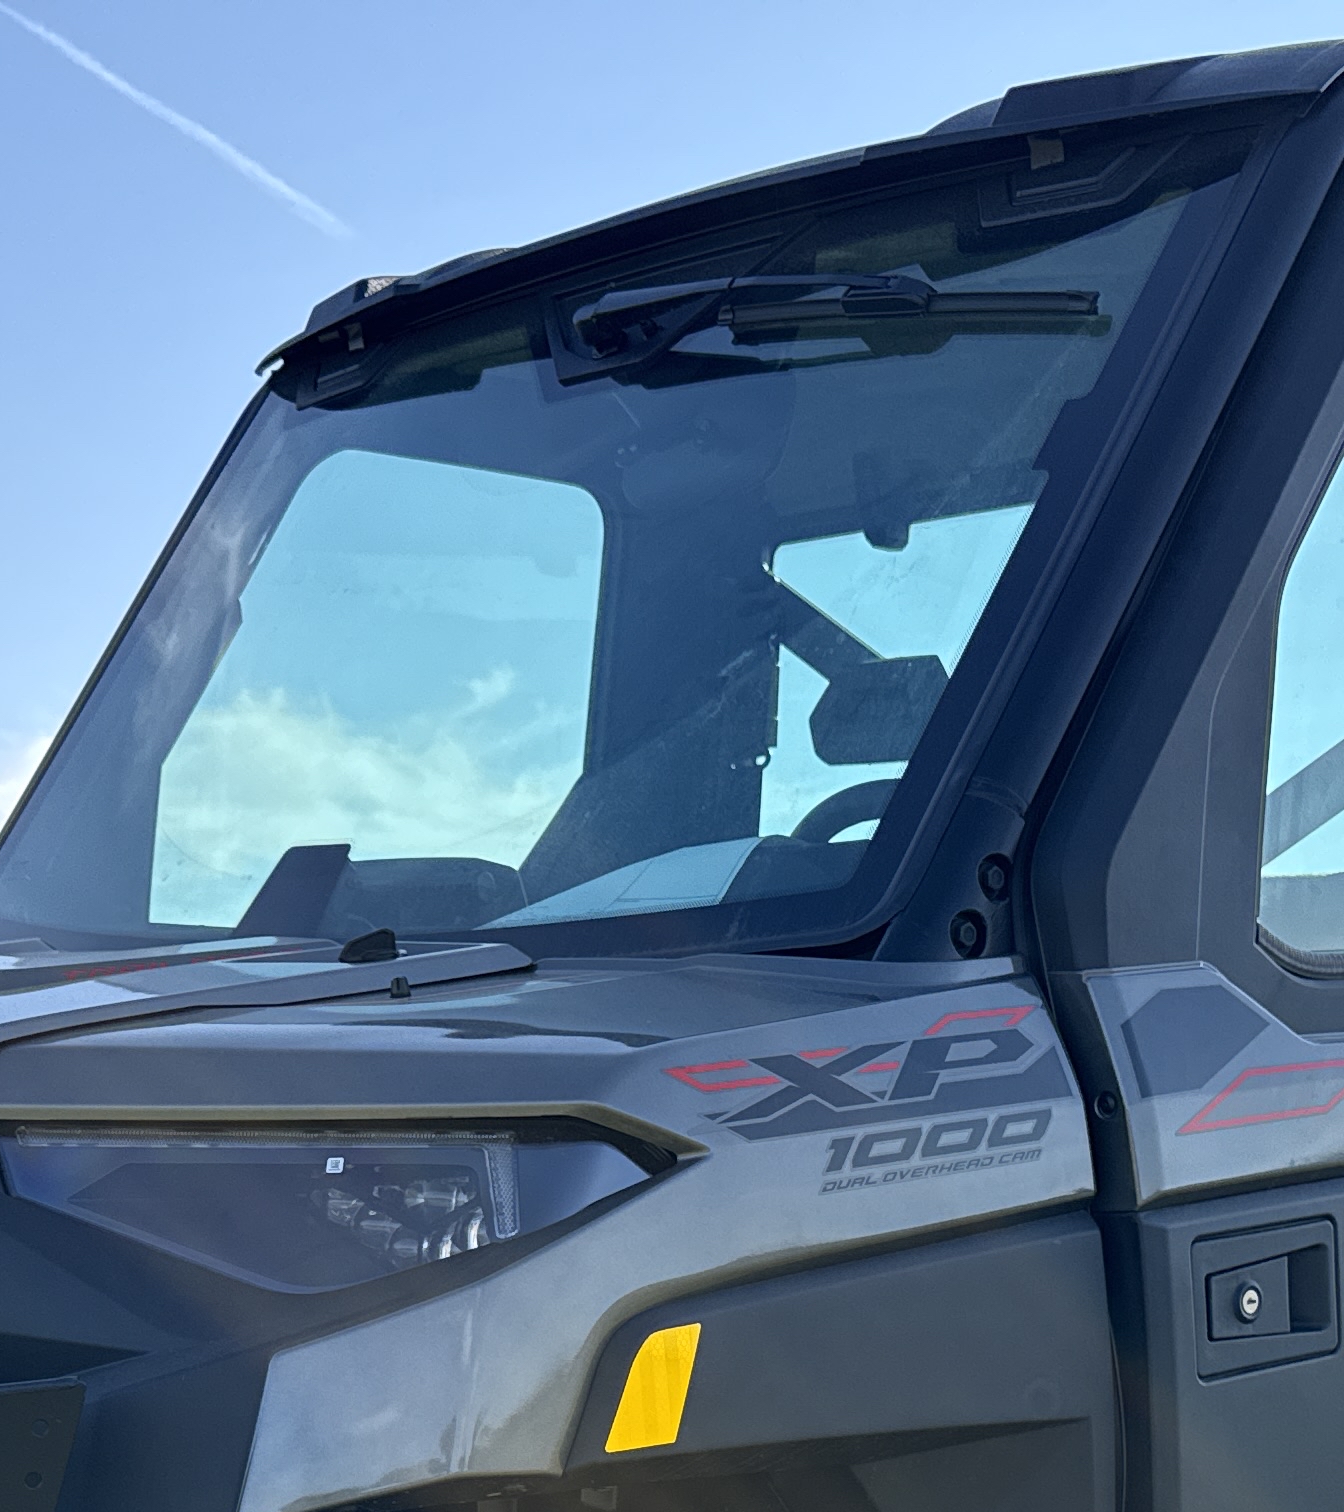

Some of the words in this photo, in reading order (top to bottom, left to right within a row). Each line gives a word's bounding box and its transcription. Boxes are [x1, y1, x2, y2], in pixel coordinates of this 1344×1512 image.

[696, 1026, 1038, 1125] XP
[821, 1175, 879, 1193] DUAL
[882, 1157, 993, 1183] OVERHEAD
[998, 1149, 1043, 1163] CAM
[824, 1108, 1053, 1174] 1000
